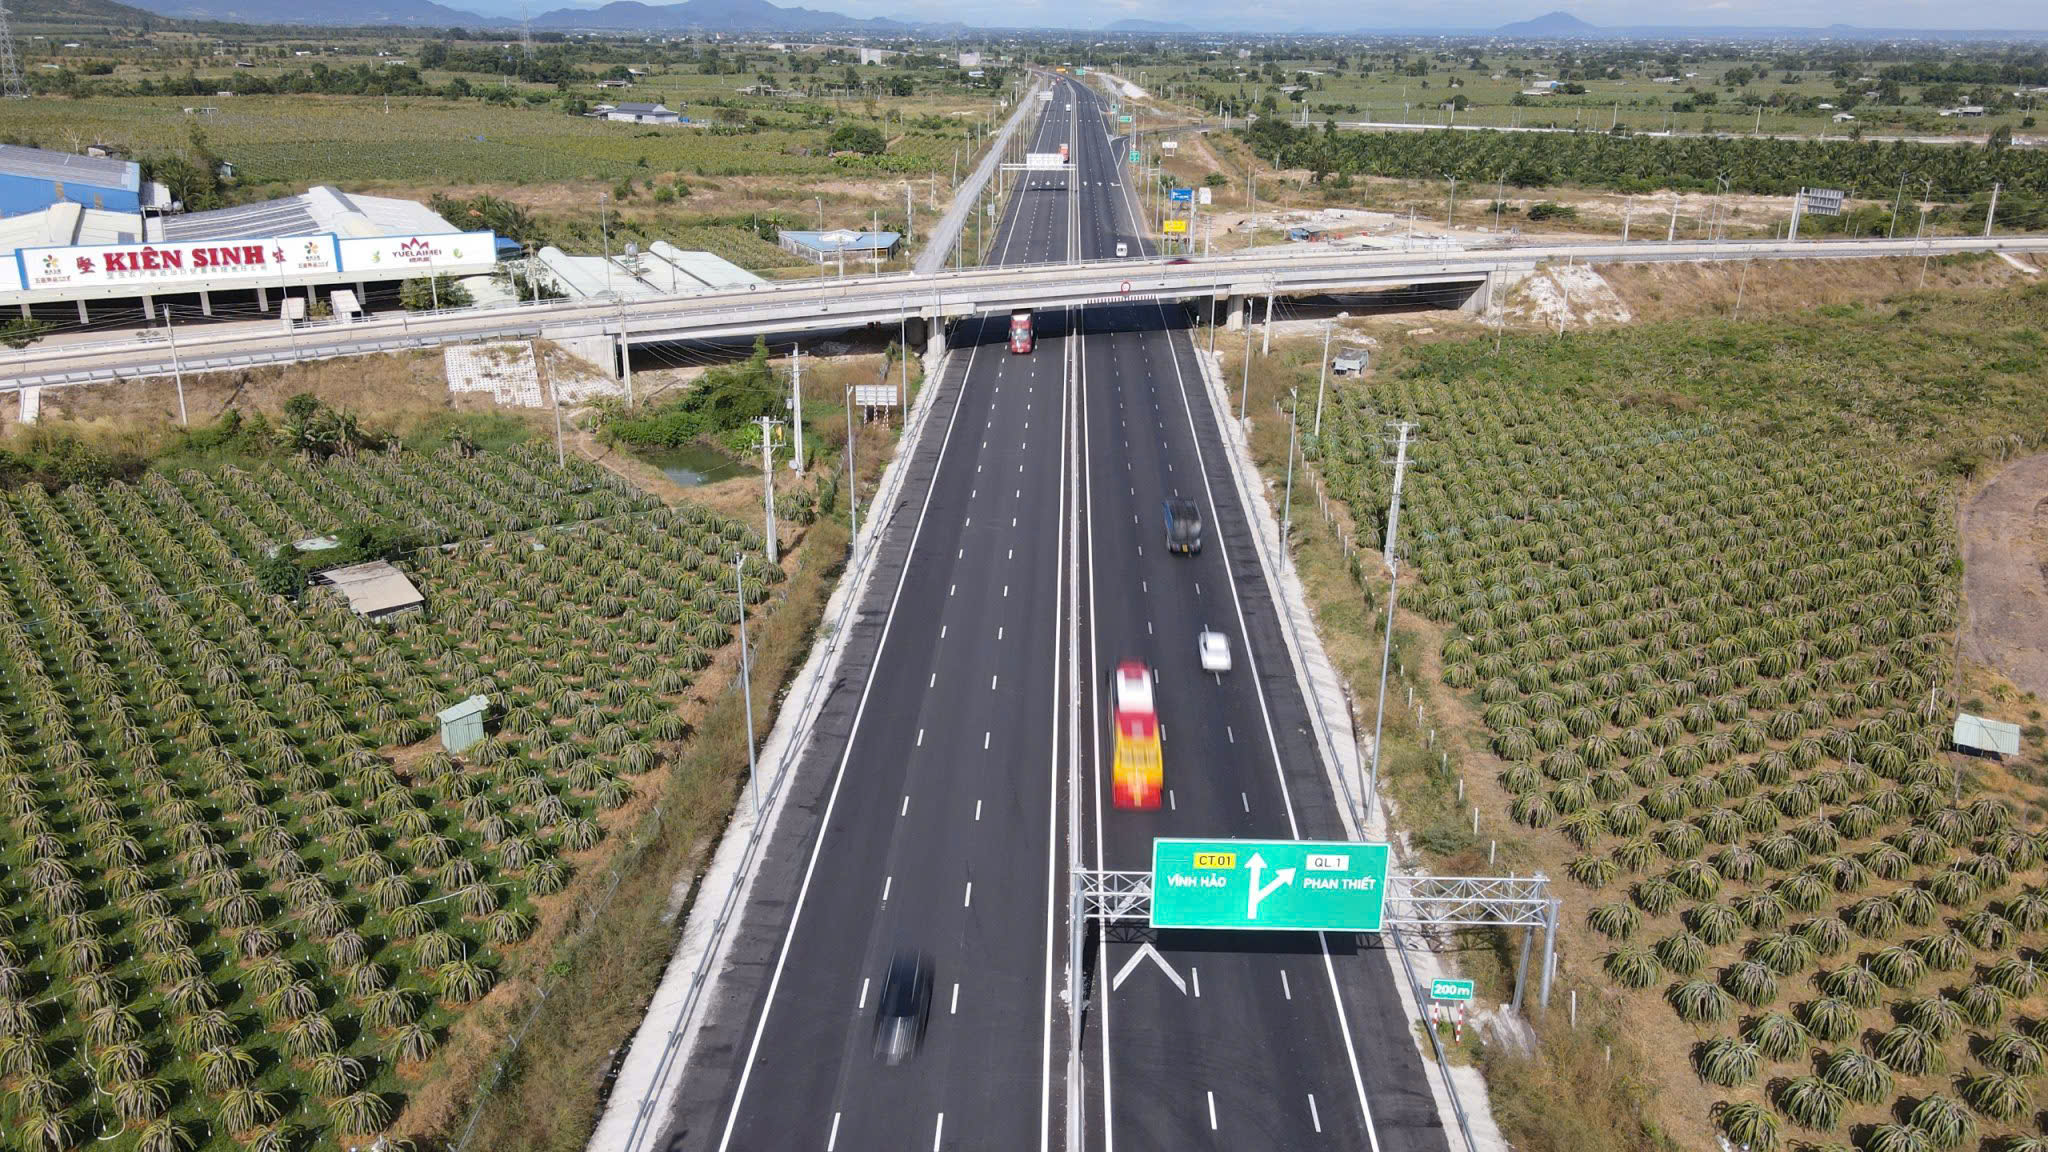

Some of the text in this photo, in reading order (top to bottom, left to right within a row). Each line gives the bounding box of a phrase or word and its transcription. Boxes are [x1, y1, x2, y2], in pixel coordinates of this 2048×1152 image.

[103, 245, 265, 272] KIÊN SINH
[1199, 855, 1231, 866] CT.01
[1303, 875, 1376, 890] PHAN THIẾT
